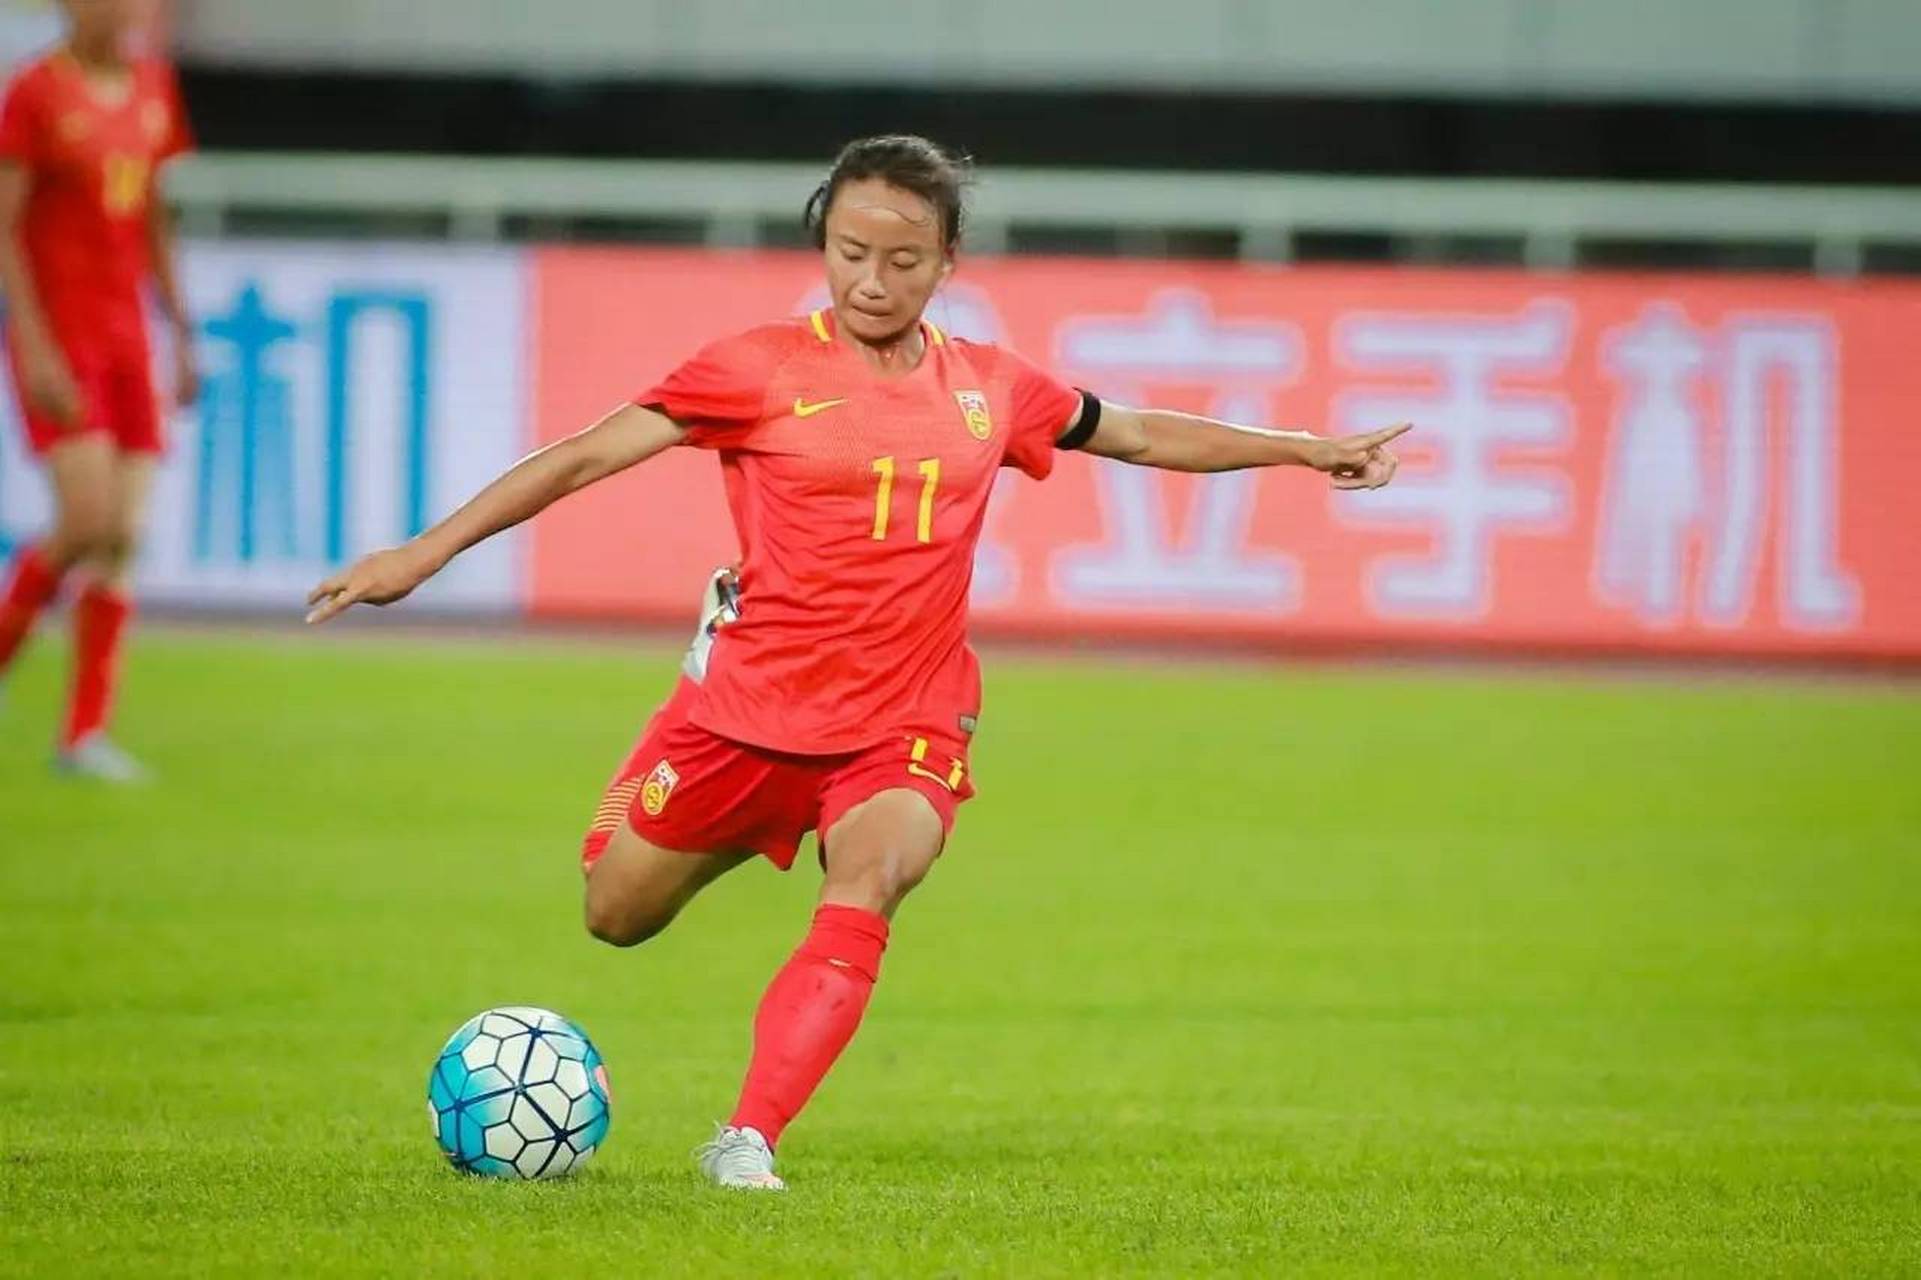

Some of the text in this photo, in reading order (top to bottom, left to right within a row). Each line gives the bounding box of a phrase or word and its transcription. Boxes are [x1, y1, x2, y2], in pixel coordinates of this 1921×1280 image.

[798, 282, 1862, 630] 立手机
[871, 455, 940, 544] 11
